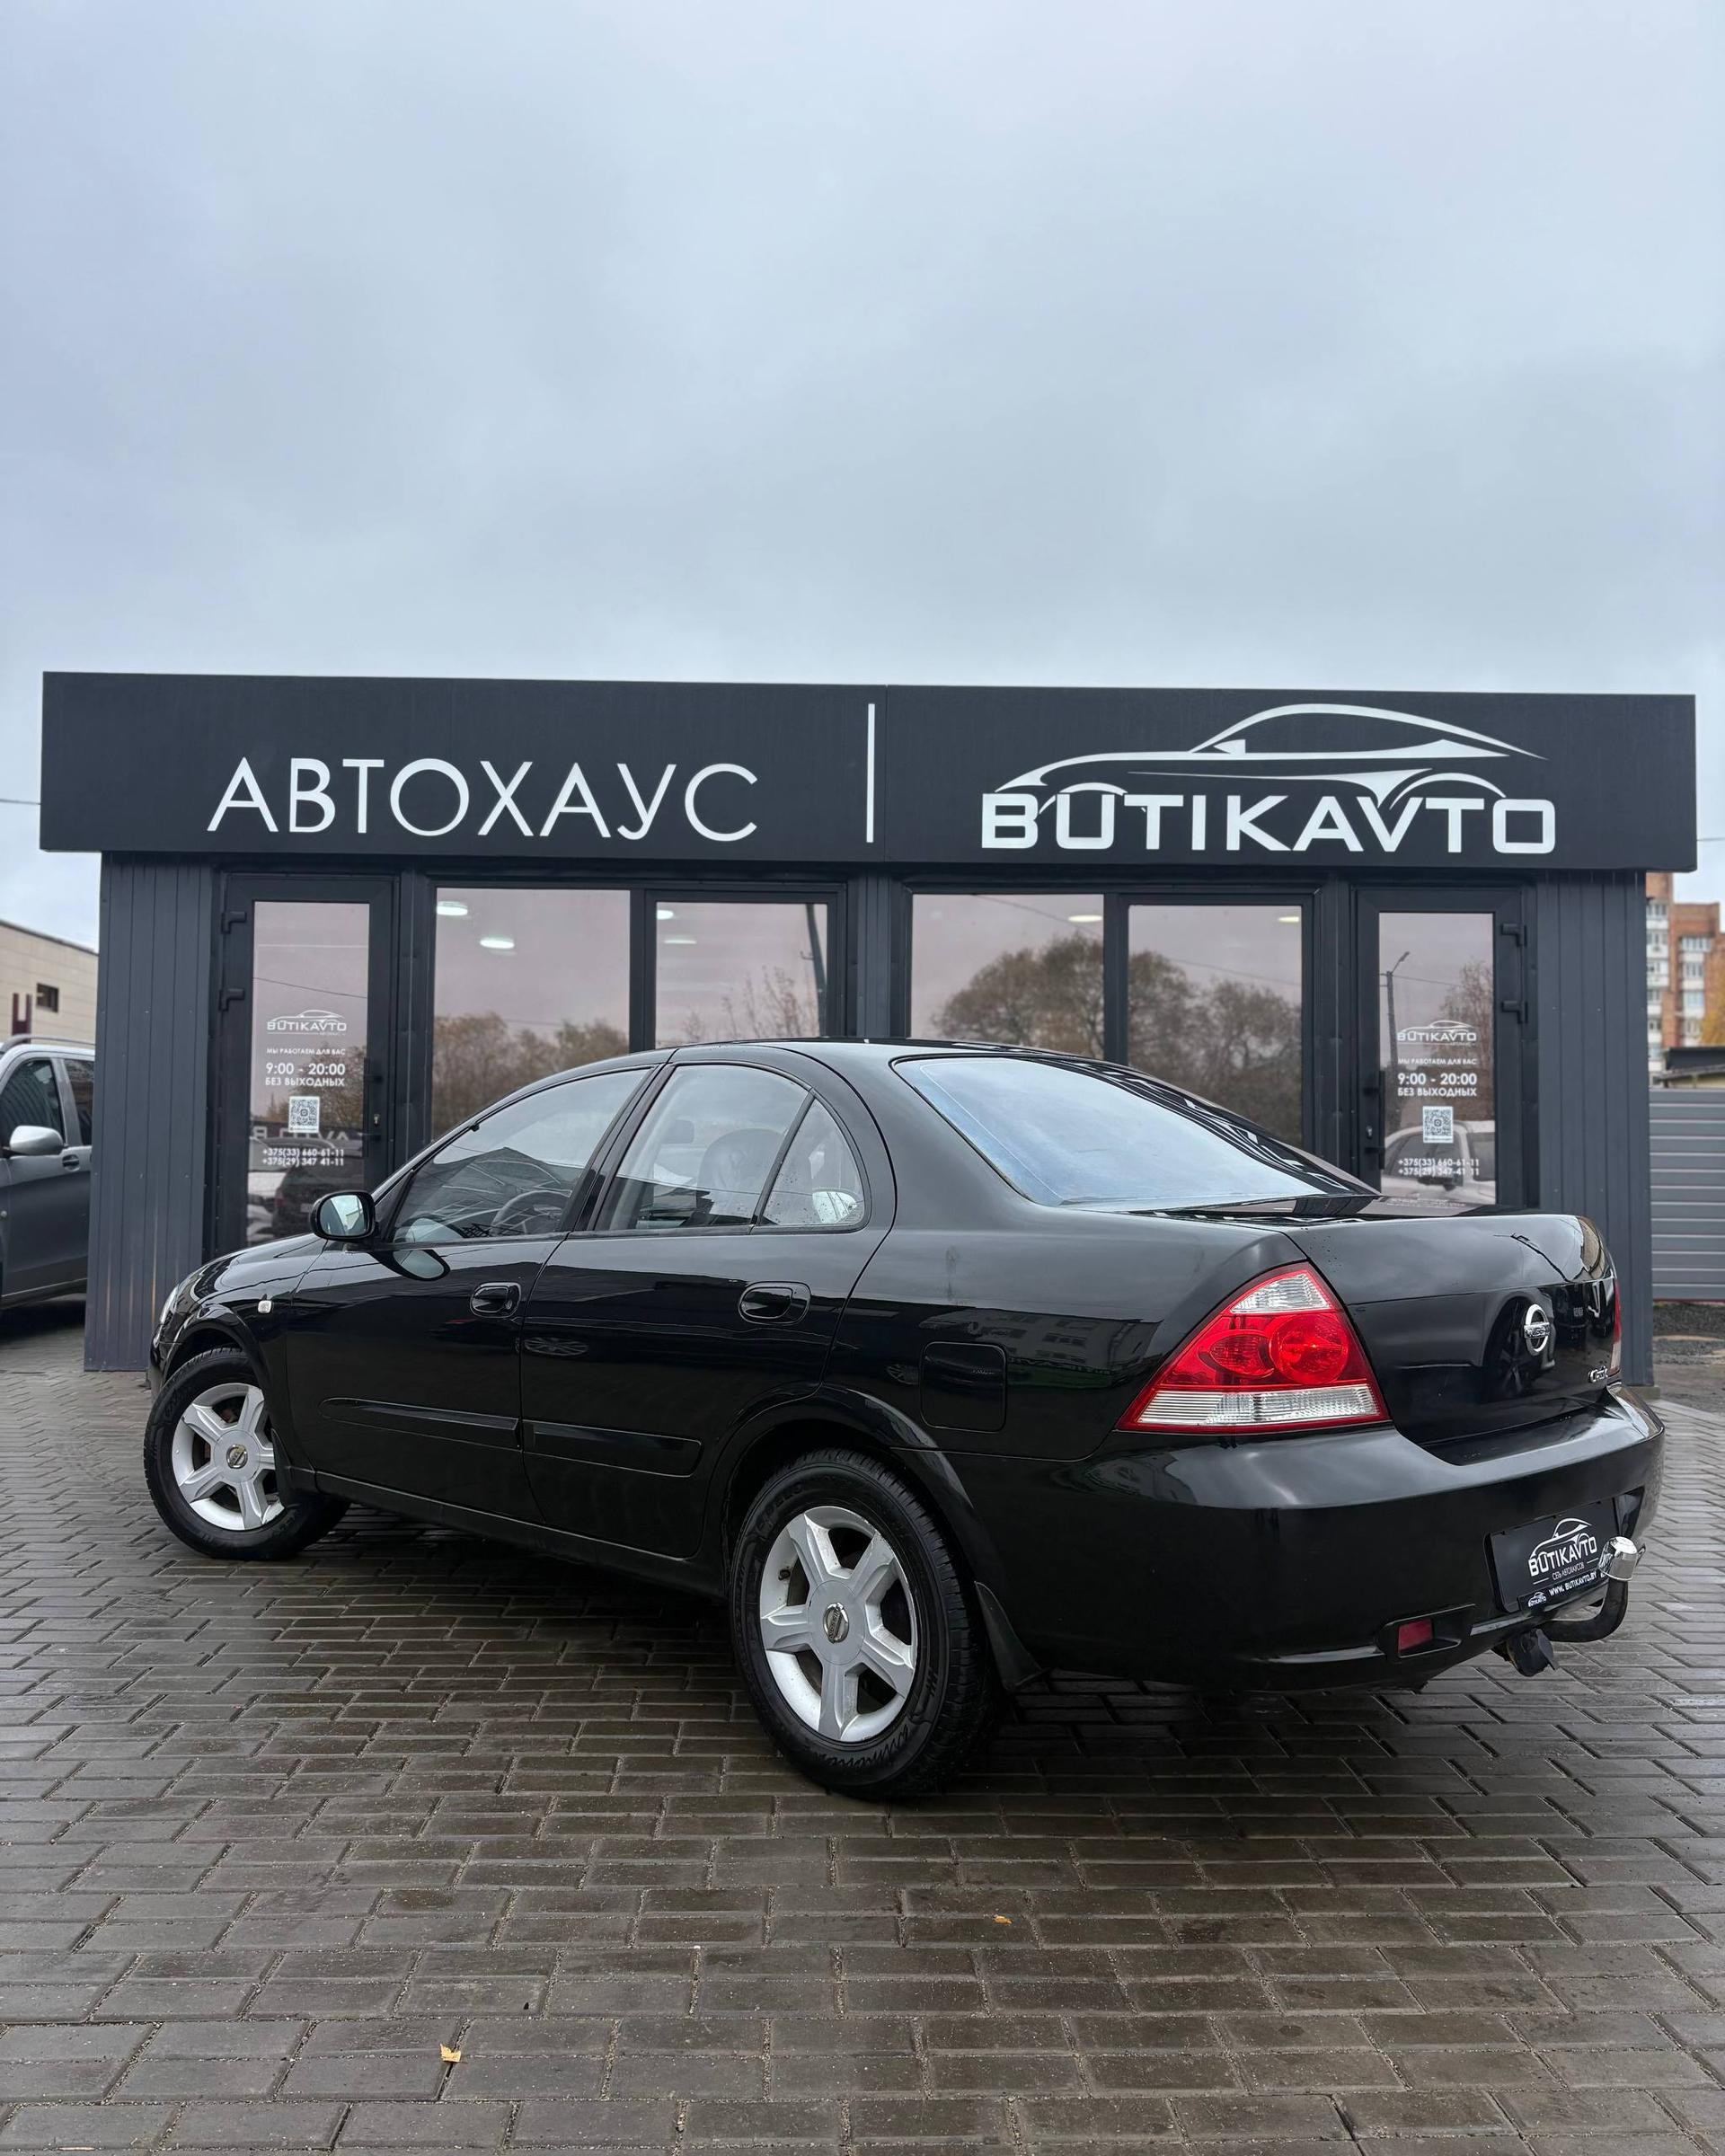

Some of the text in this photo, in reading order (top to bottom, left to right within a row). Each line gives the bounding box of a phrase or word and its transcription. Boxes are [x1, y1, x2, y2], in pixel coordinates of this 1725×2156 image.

[207, 756, 758, 842] АВТОХАУС
[981, 792, 1556, 854] BUTIKAVTO
[267, 1021, 347, 1031] BUTIKAVTO
[1397, 1031, 1477, 1042] BUTIKAVTO
[265, 1063, 295, 1074] 9:00
[308, 1063, 346, 1075] 20:00
[265, 1077, 345, 1087] БЕЗ ВЫХОДНЫХ
[1397, 1073, 1427, 1085] 9:00
[1440, 1073, 1477, 1085] 20:00
[1398, 1088, 1477, 1097] БЕЗ ВЫХОДНЫХ
[1528, 1536, 1597, 1577] BUTIKAVTO
